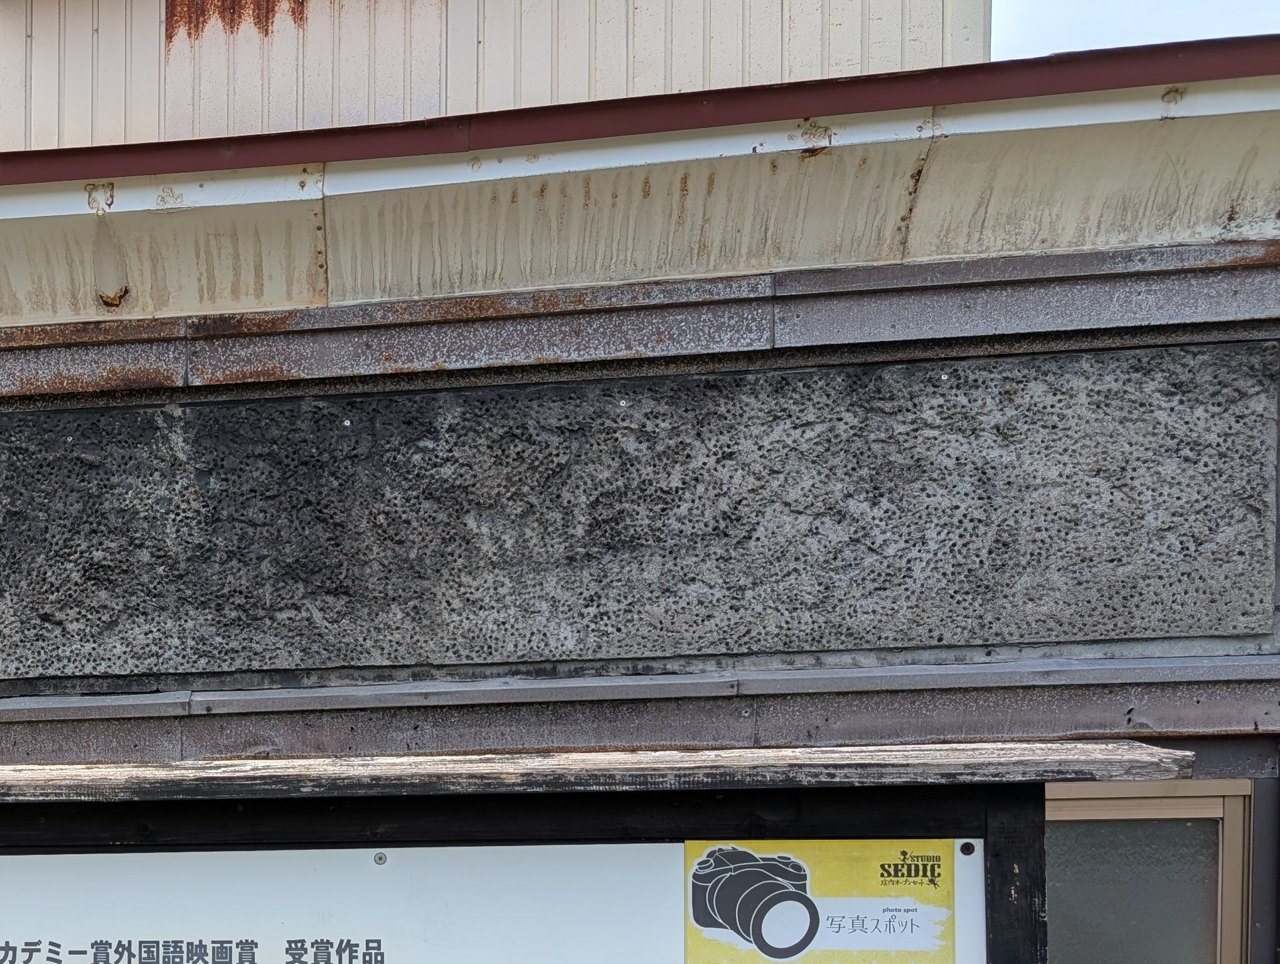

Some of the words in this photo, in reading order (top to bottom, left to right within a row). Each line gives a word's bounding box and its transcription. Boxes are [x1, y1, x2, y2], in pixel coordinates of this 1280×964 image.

[910, 855, 941, 863] STUDIO
[880, 863, 941, 878] SEDIC
[825, 914, 920, 934] 写真スポット
